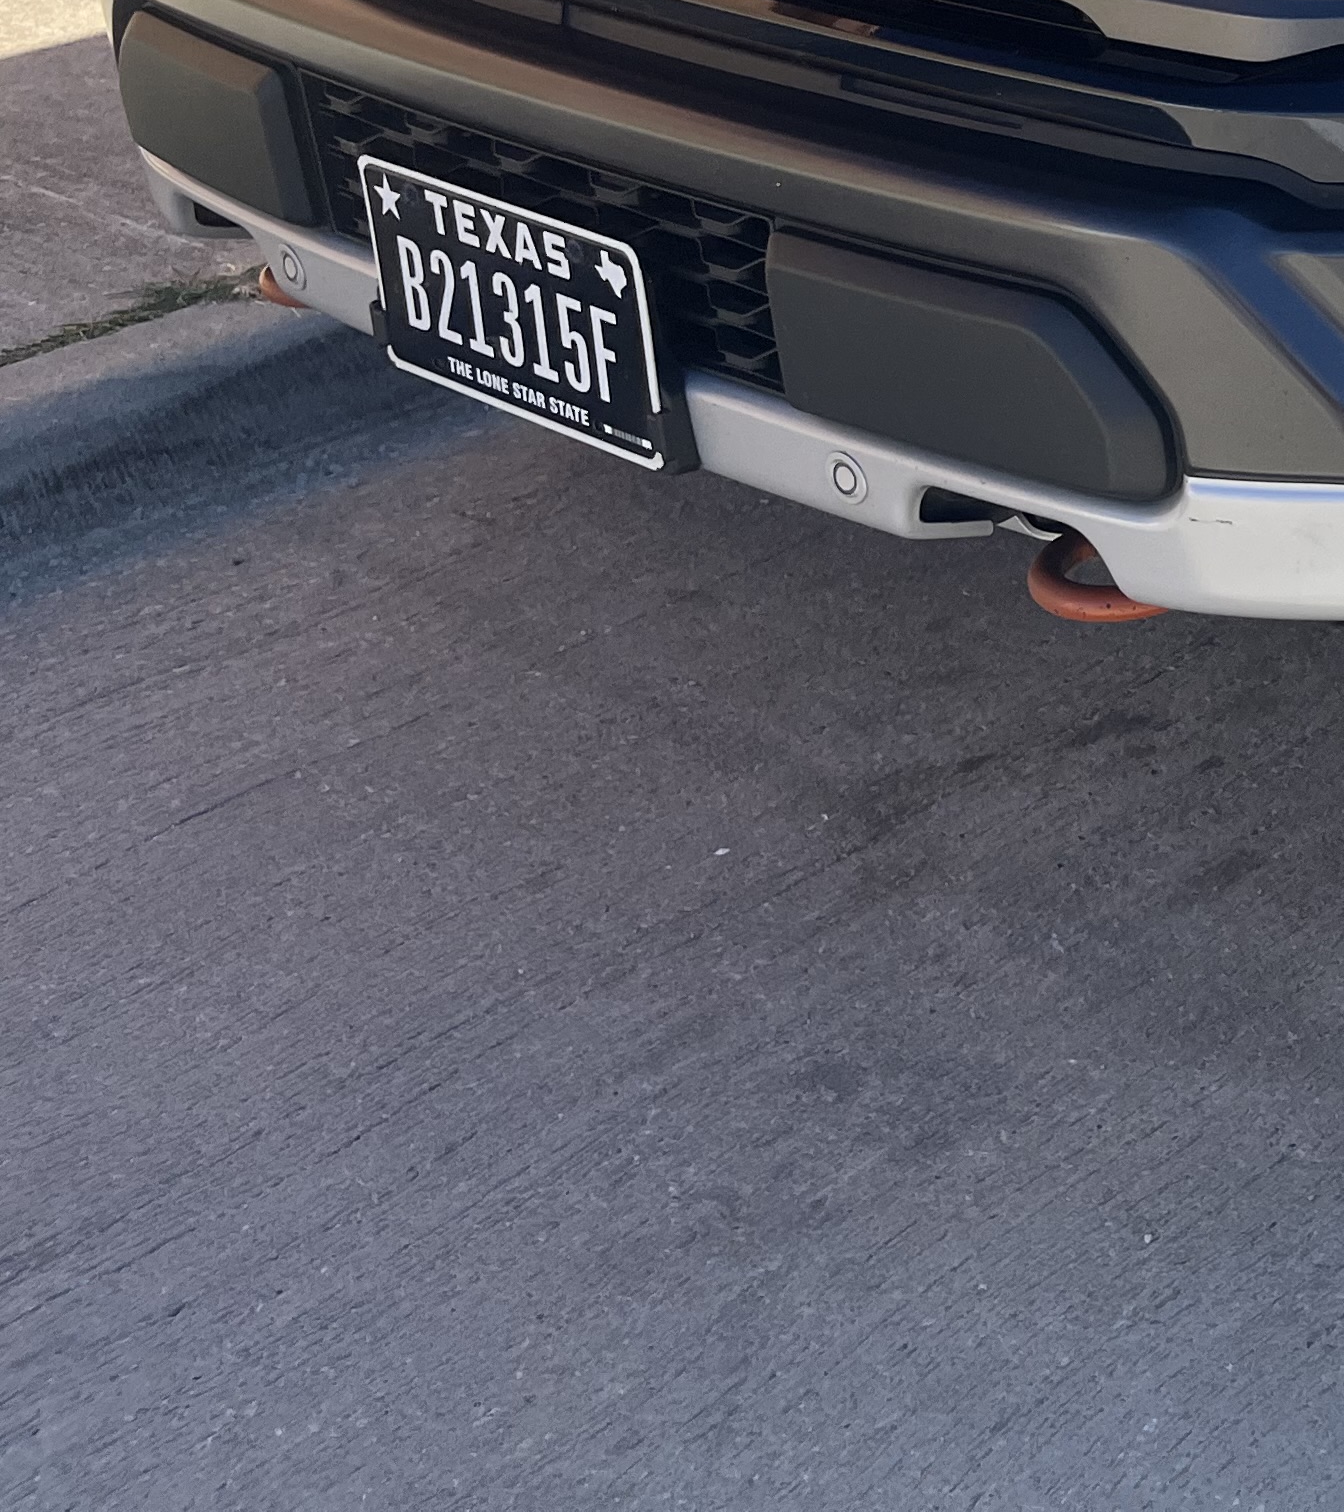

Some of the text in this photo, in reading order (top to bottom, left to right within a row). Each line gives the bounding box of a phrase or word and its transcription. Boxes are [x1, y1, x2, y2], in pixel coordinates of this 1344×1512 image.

[424, 189, 572, 281] TEXAS
[396, 235, 618, 404] B21315F
[447, 356, 590, 427] THE LONE STAR STATE
